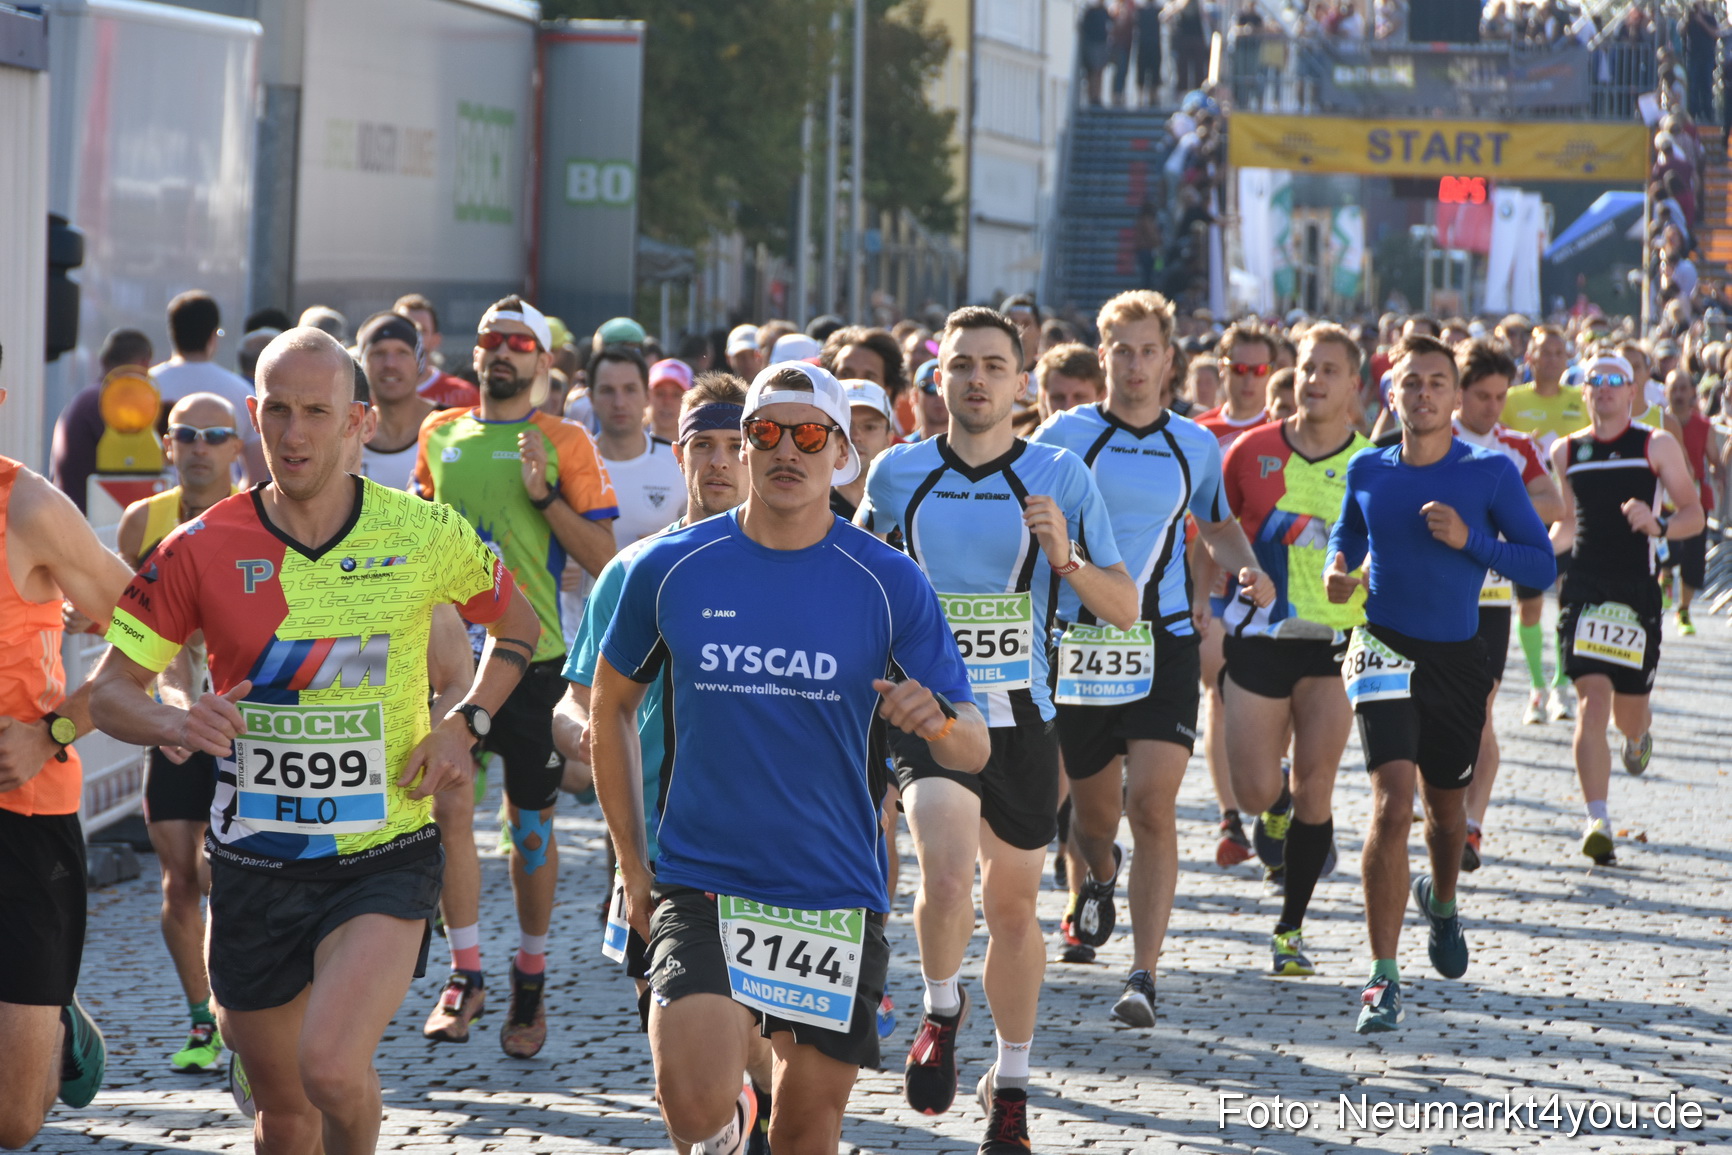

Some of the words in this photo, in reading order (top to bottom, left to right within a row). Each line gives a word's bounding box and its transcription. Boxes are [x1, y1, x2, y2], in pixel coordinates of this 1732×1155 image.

[1367, 128, 1511, 165] START
[714, 610, 737, 618] JAKO
[952, 629, 1020, 659] 656
[1586, 620, 1639, 647] 1127
[700, 643, 838, 680] SYSCAD
[1069, 650, 1142, 675] 2435
[694, 682, 841, 701] www.metallbau-cad.de
[1074, 682, 1136, 696] THOMAS
[245, 710, 368, 738] BOCK
[252, 747, 368, 790] 2699
[275, 795, 338, 825] FLO
[736, 927, 842, 985] 2144
[742, 977, 831, 1013] ANDREAS
